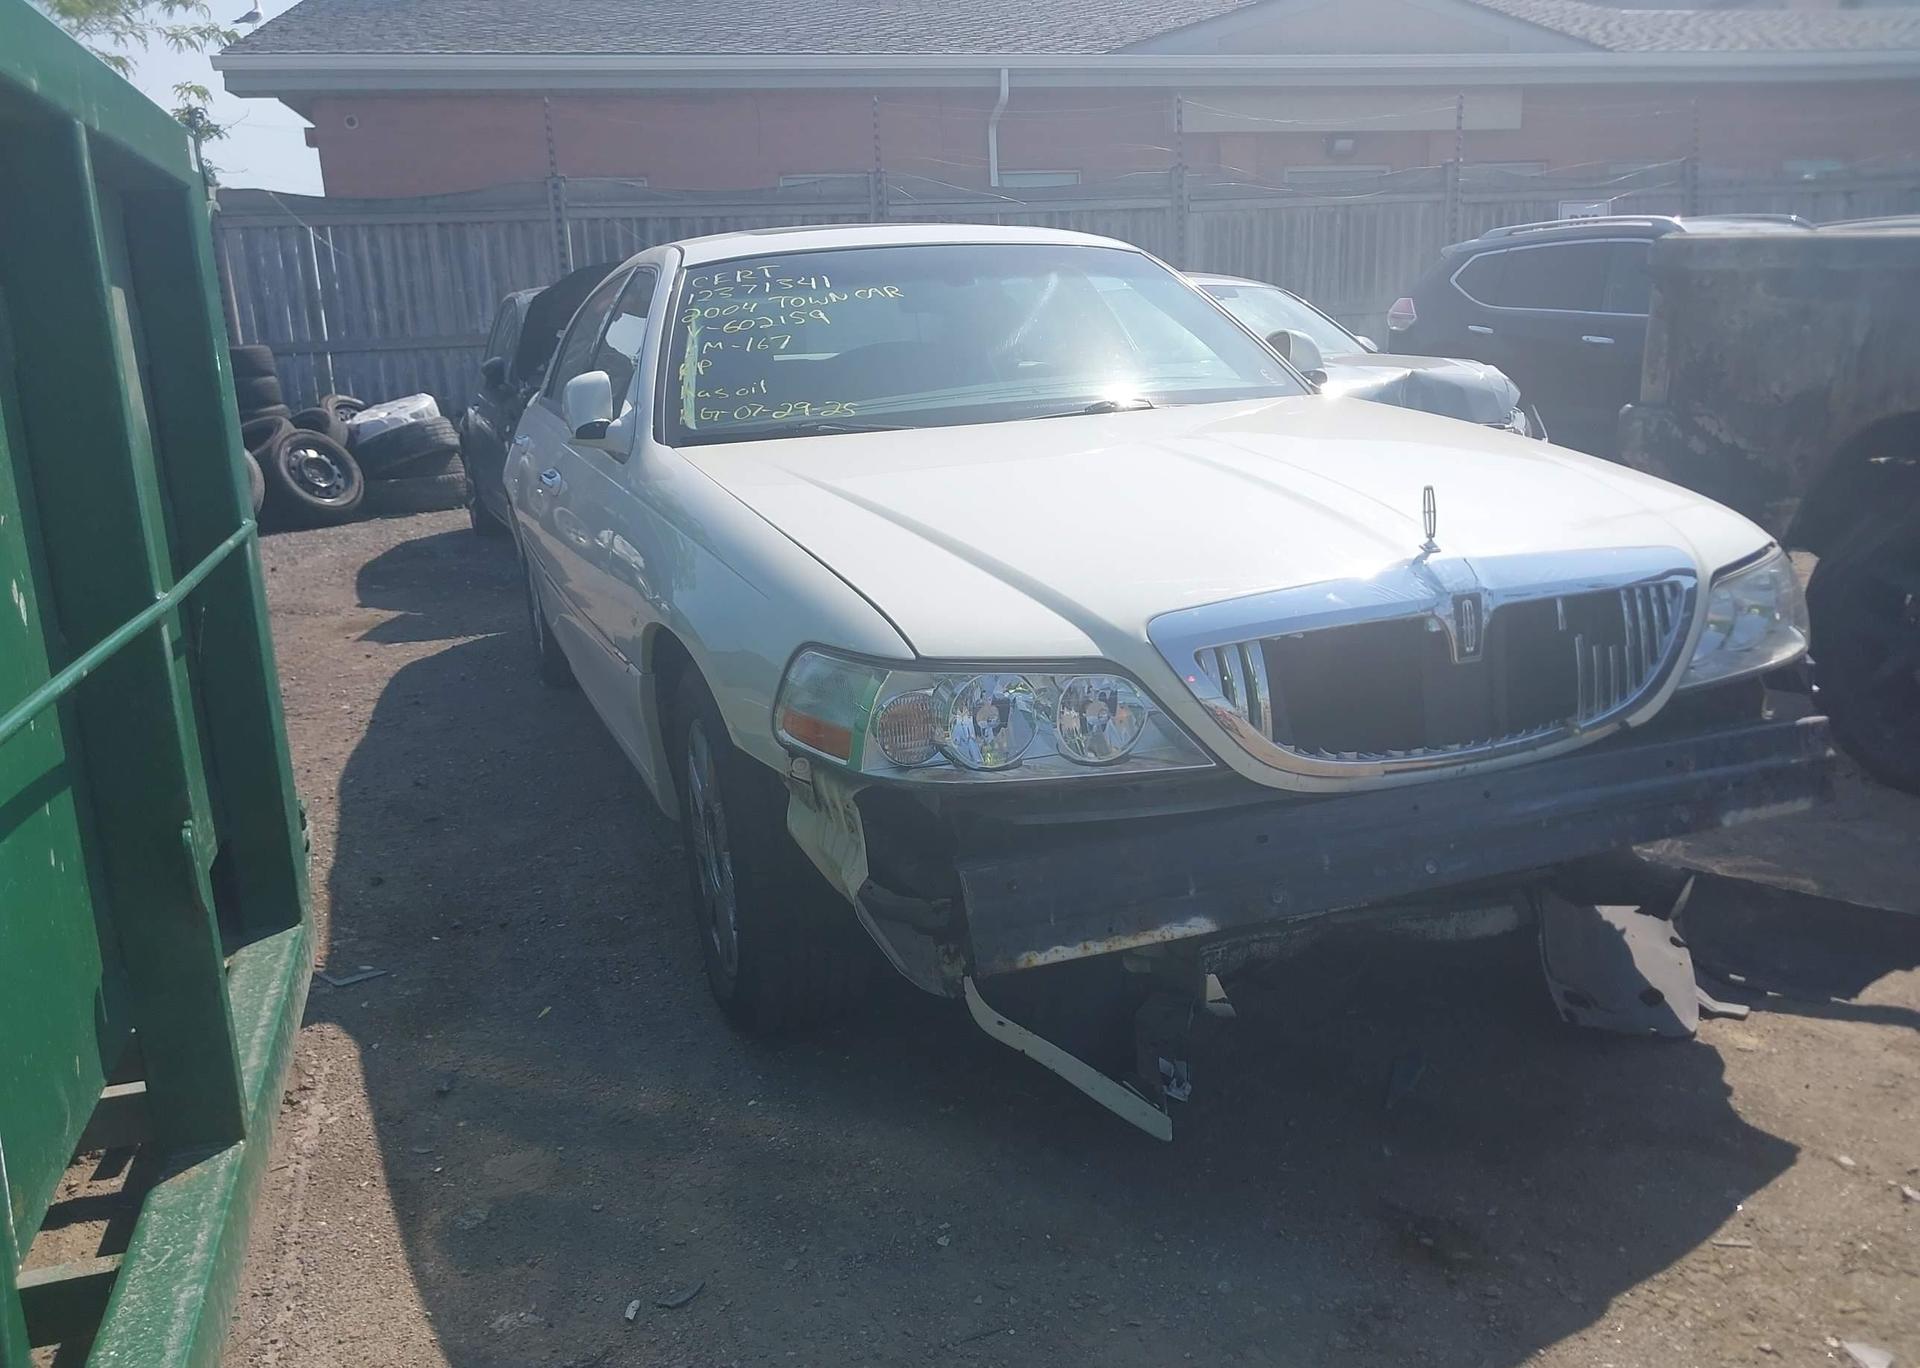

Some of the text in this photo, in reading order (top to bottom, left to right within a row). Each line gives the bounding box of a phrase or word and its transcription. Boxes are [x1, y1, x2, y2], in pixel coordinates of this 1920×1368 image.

[692, 265, 781, 287] CERT
[681, 285, 905, 324] 2004 TOWN CAR
